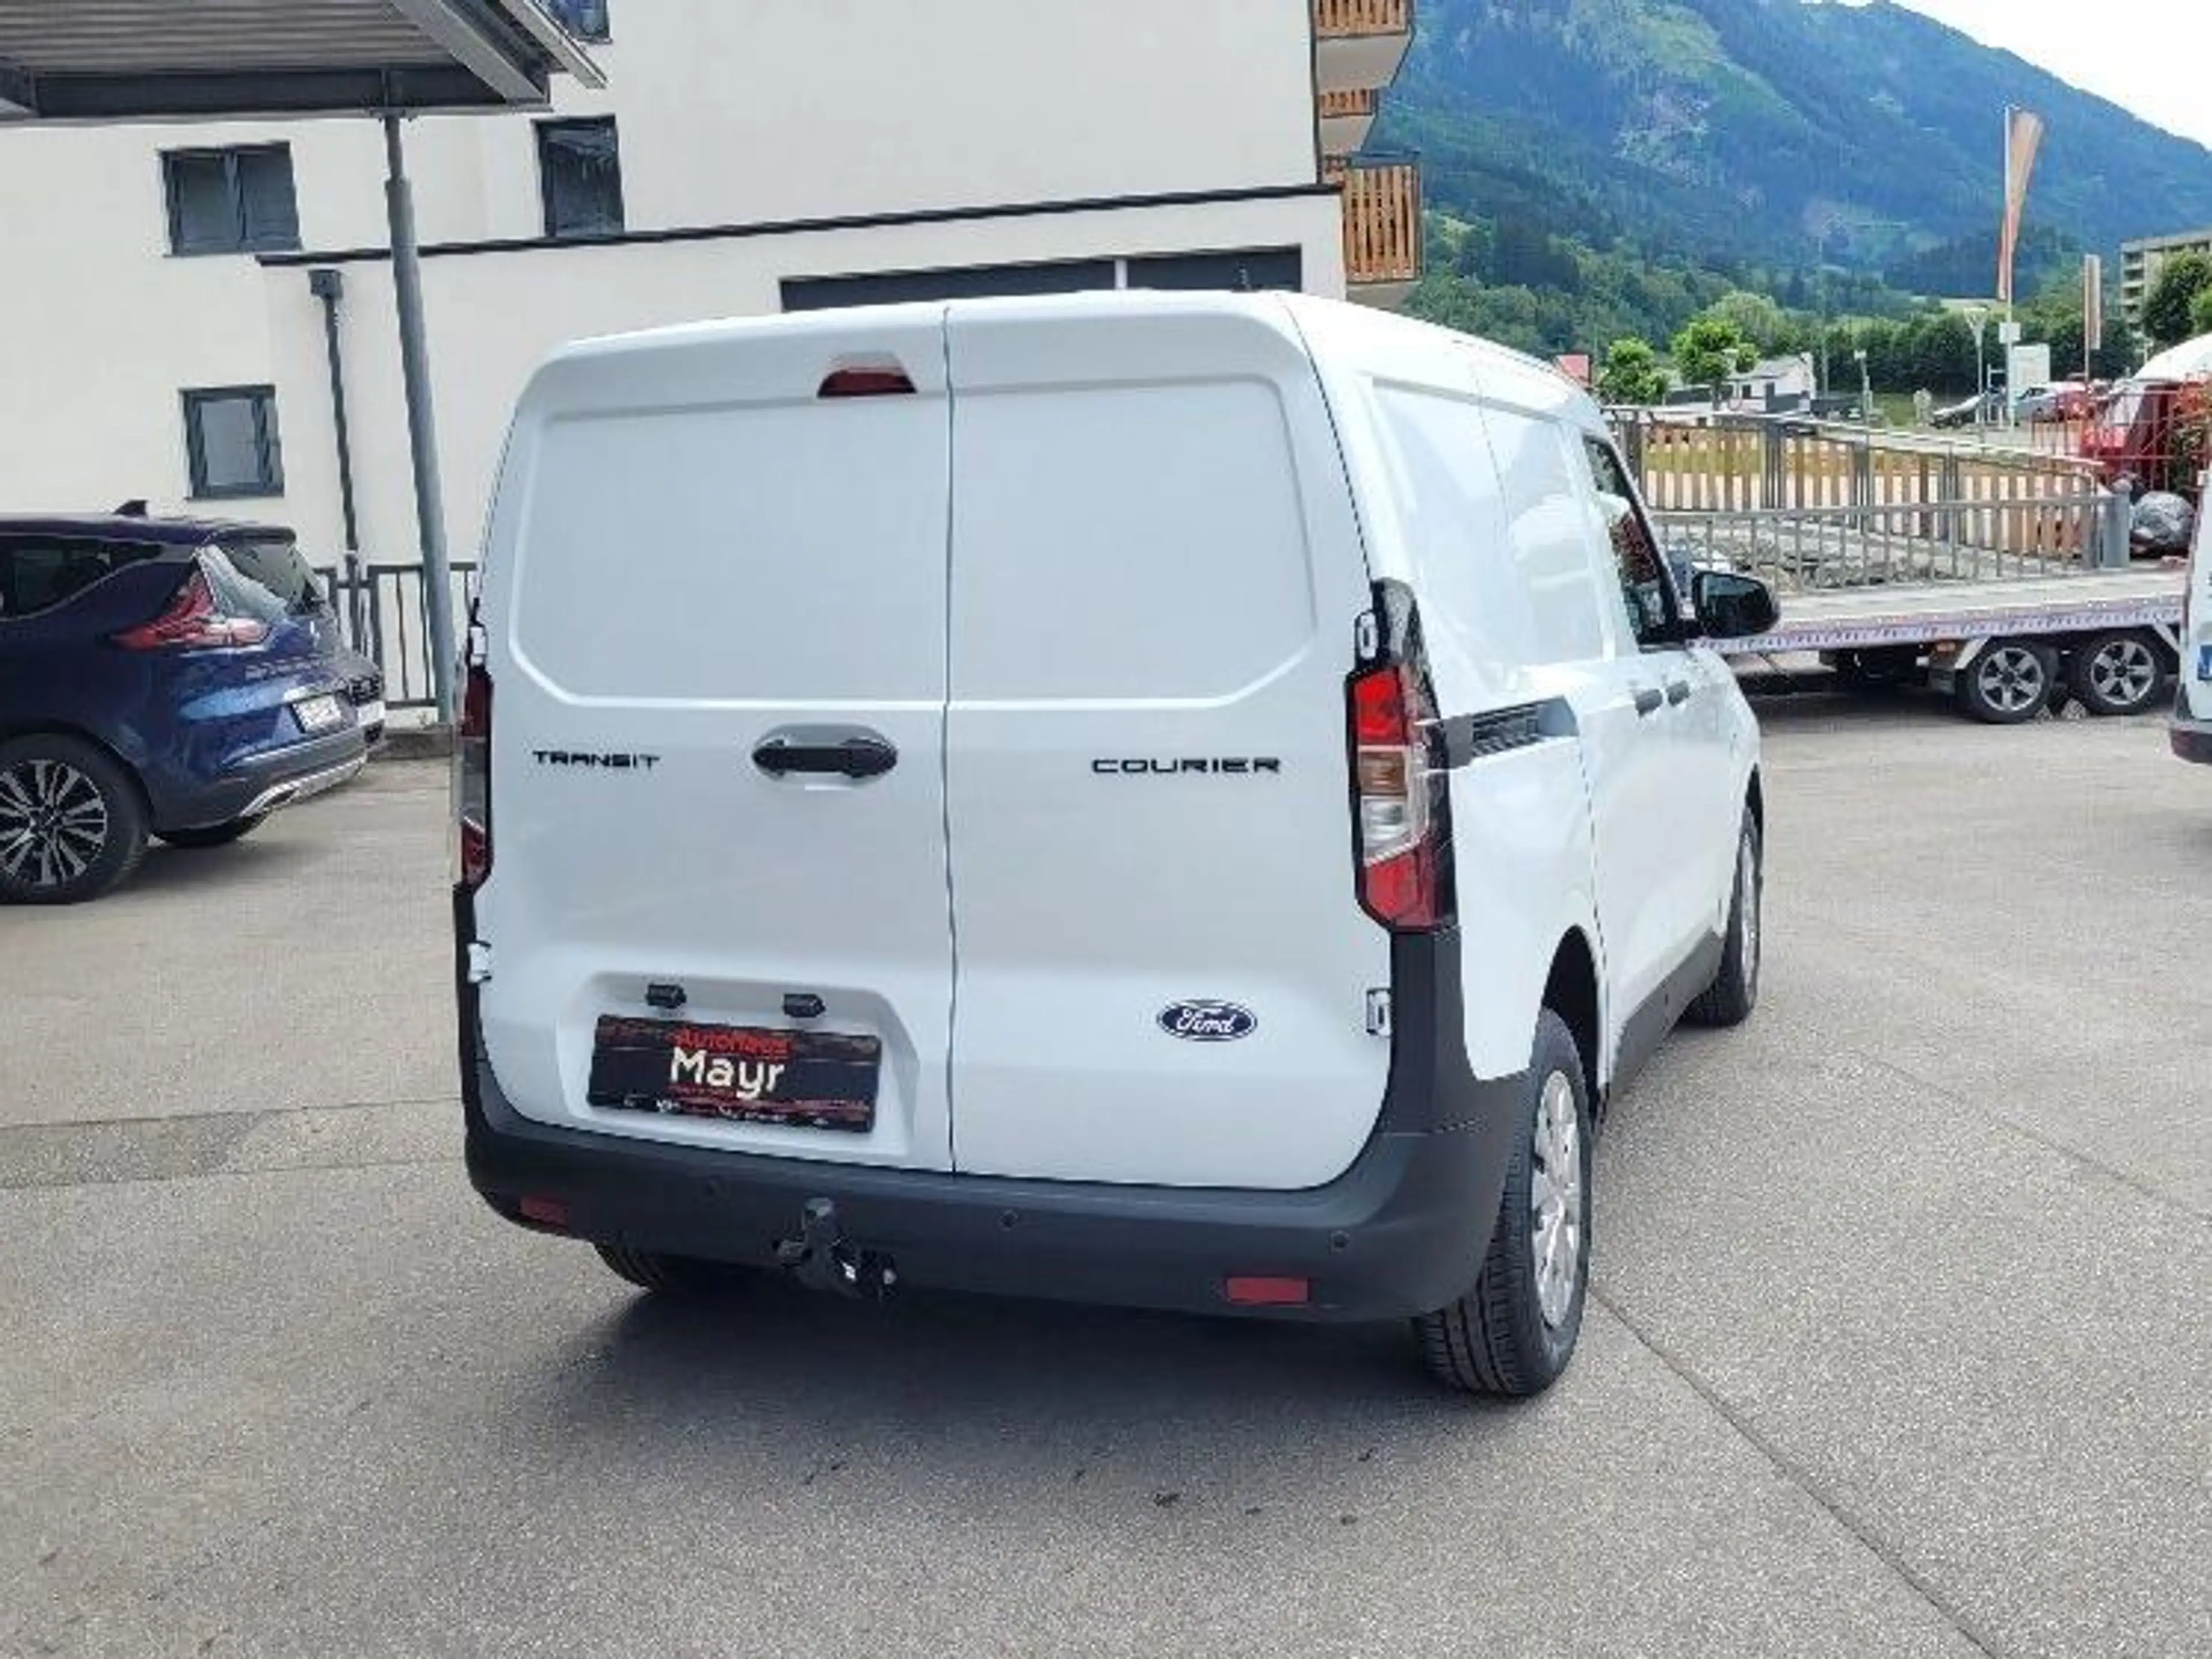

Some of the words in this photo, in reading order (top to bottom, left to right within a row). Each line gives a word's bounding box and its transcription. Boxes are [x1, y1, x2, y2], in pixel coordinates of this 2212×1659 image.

[532, 750, 661, 770] TRANSIT
[1092, 758, 1281, 774] COURIER
[1176, 1007, 1237, 1033] Ford
[669, 1046, 786, 1099] Mayr
